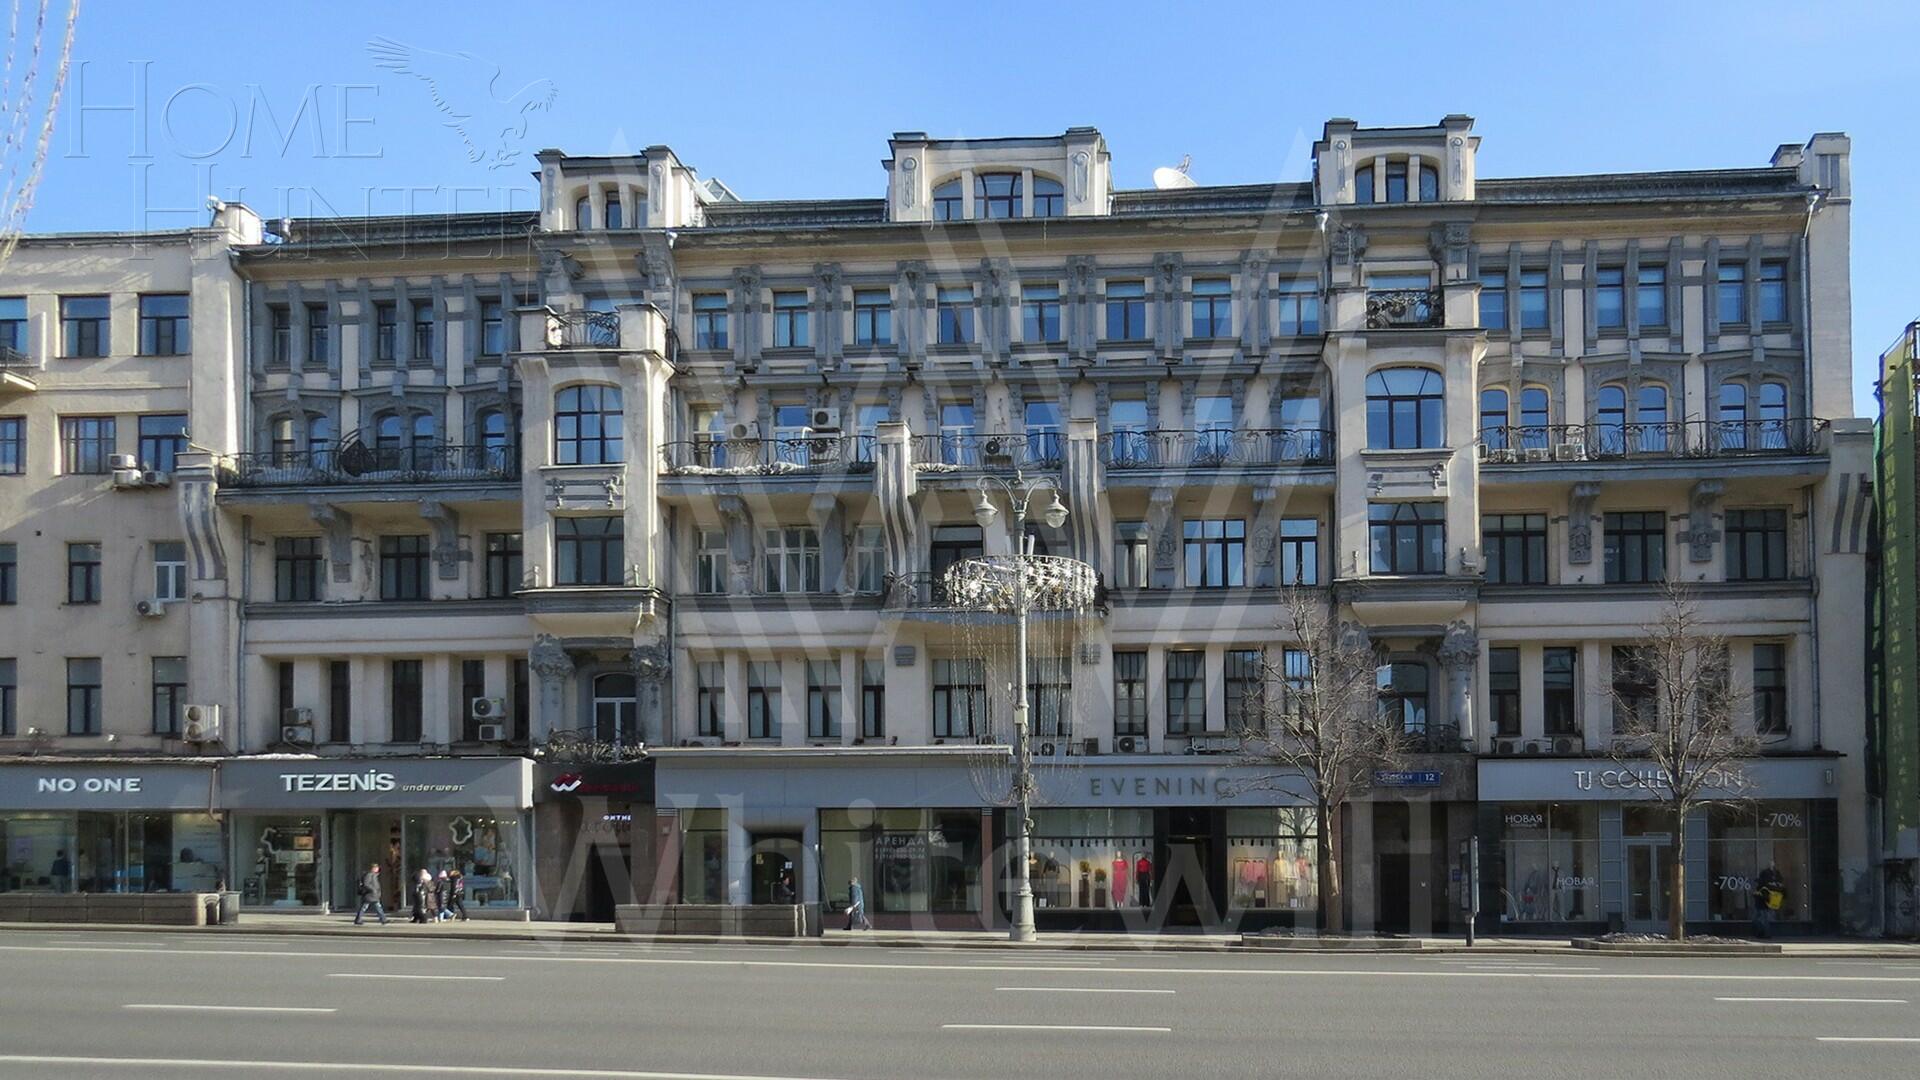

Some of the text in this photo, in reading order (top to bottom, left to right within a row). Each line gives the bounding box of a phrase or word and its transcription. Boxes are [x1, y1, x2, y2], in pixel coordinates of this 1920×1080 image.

[1425, 773, 1435, 782] 12
[1574, 769, 1744, 791] TJ COLLETON
[38, 777, 142, 793] NO ONE
[401, 784, 465, 792] underwear
[1505, 814, 1543, 824] НОВАЯ
[1763, 813, 1802, 828] -70%
[875, 836, 925, 847] АРЕНДА
[1556, 876, 1594, 887] НОВАЯ
[1713, 876, 1752, 890] -70%
